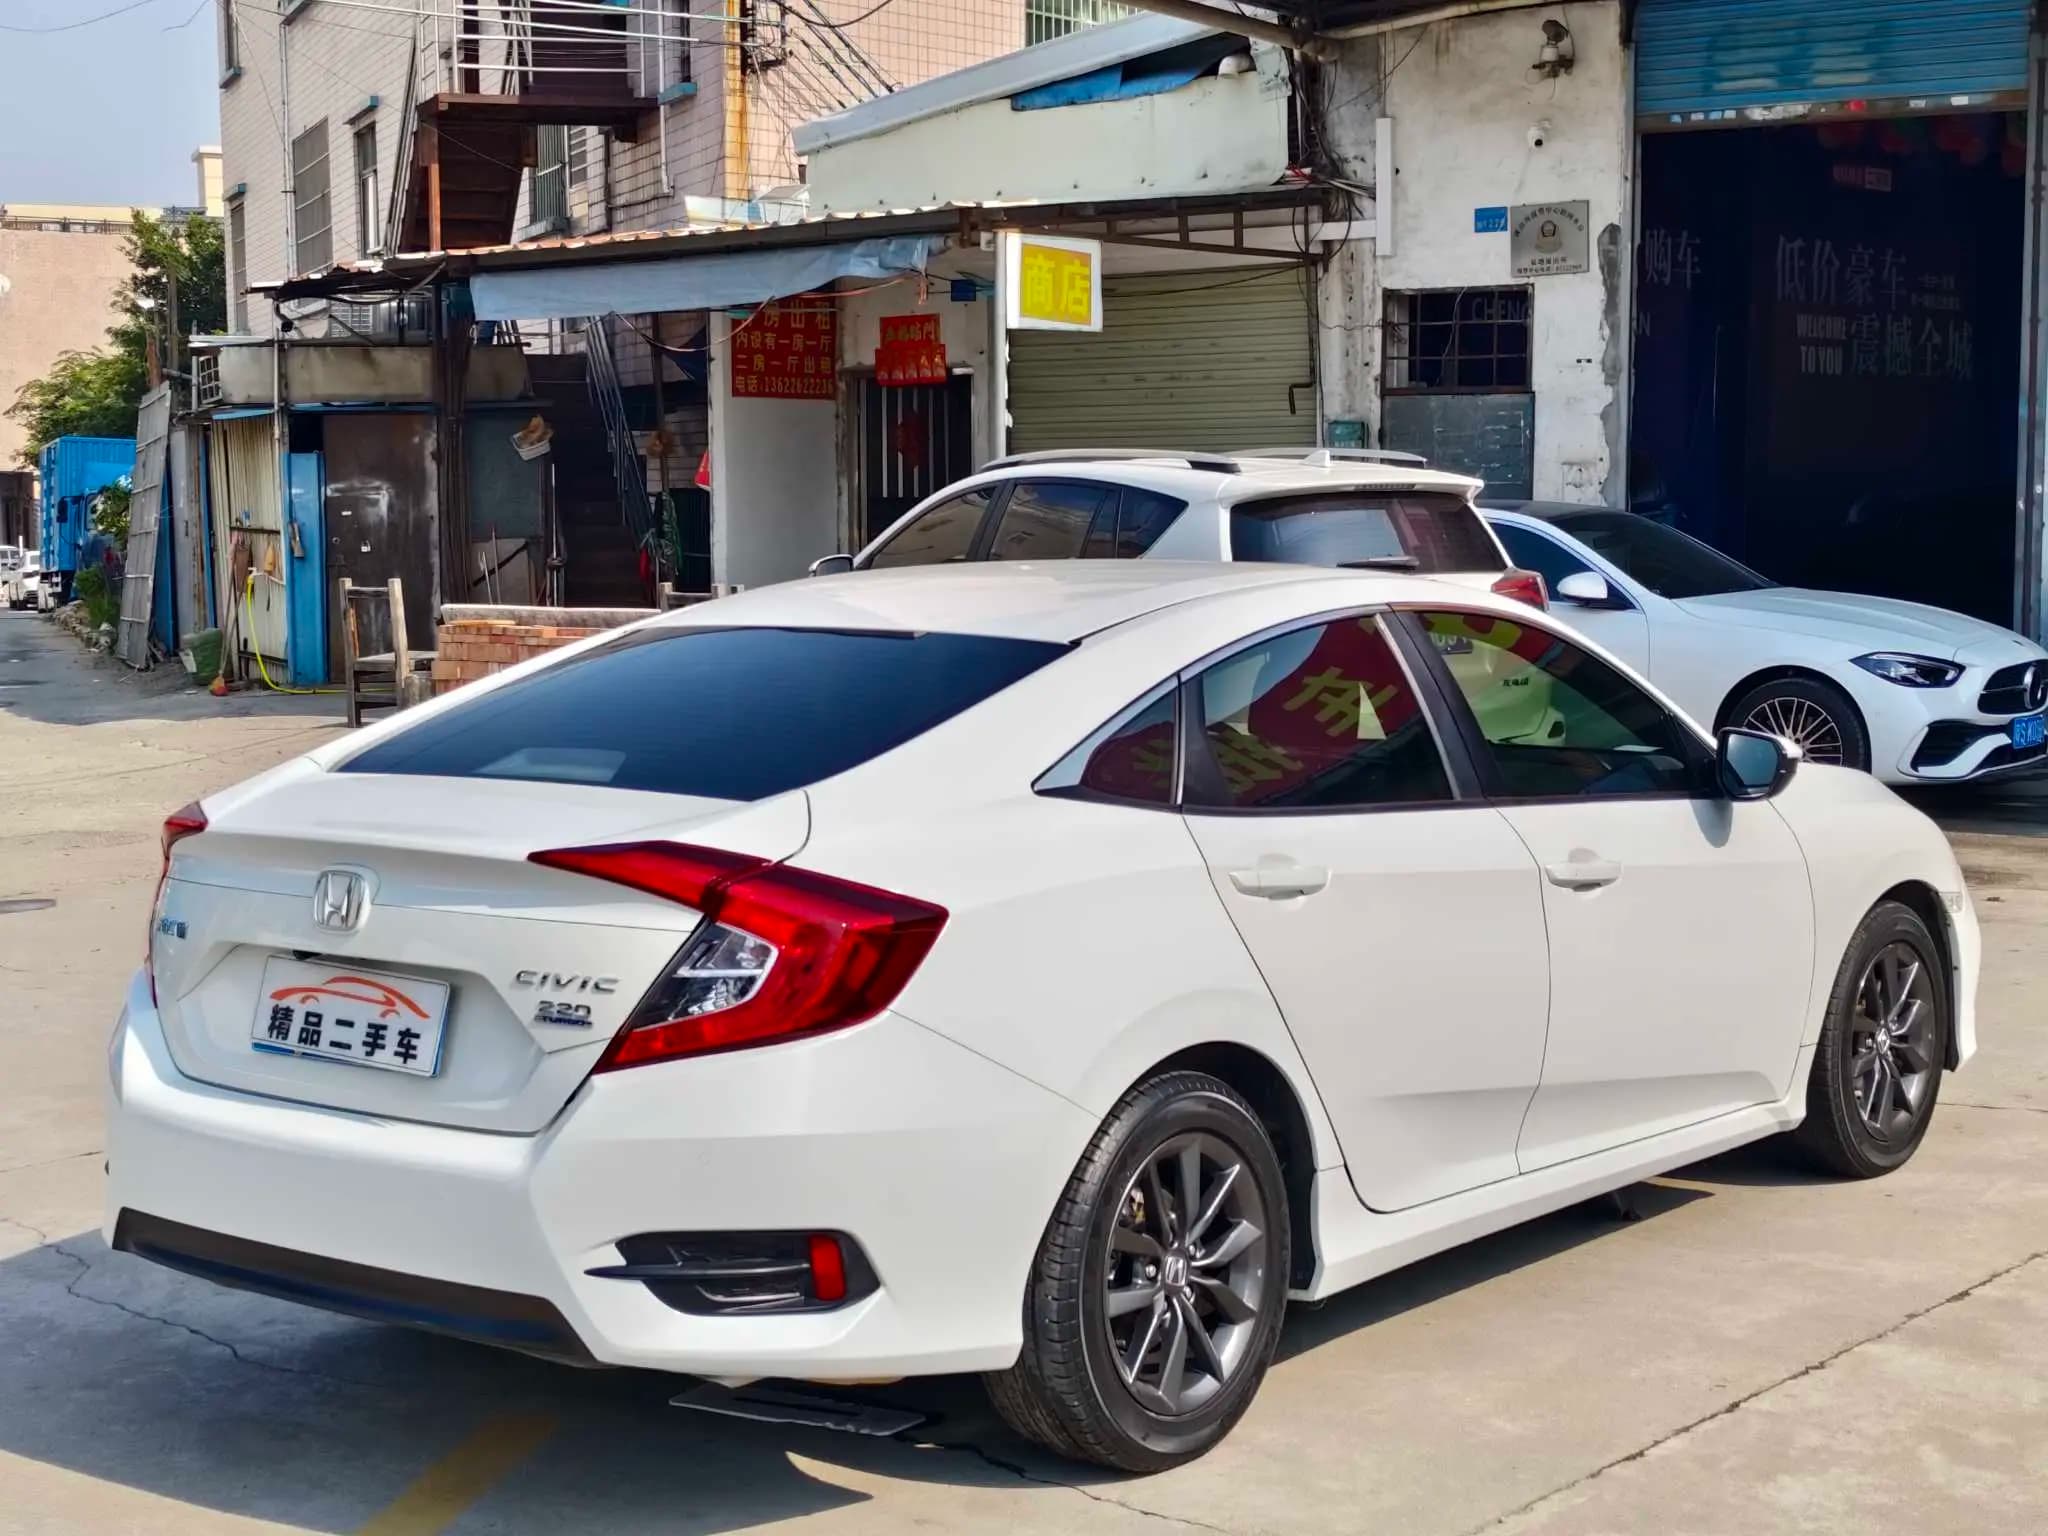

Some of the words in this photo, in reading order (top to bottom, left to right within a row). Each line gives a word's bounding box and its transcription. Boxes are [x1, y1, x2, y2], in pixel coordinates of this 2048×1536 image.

[1777, 235, 1907, 310] 低价豪车
[1797, 314, 1848, 340] WELCOME
[1851, 312, 1973, 379] 震撼全城
[1800, 346, 1816, 375] TO
[1817, 346, 1843, 375] YOU
[516, 970, 620, 993] CIVIC
[267, 1004, 421, 1065] 精品二手车
